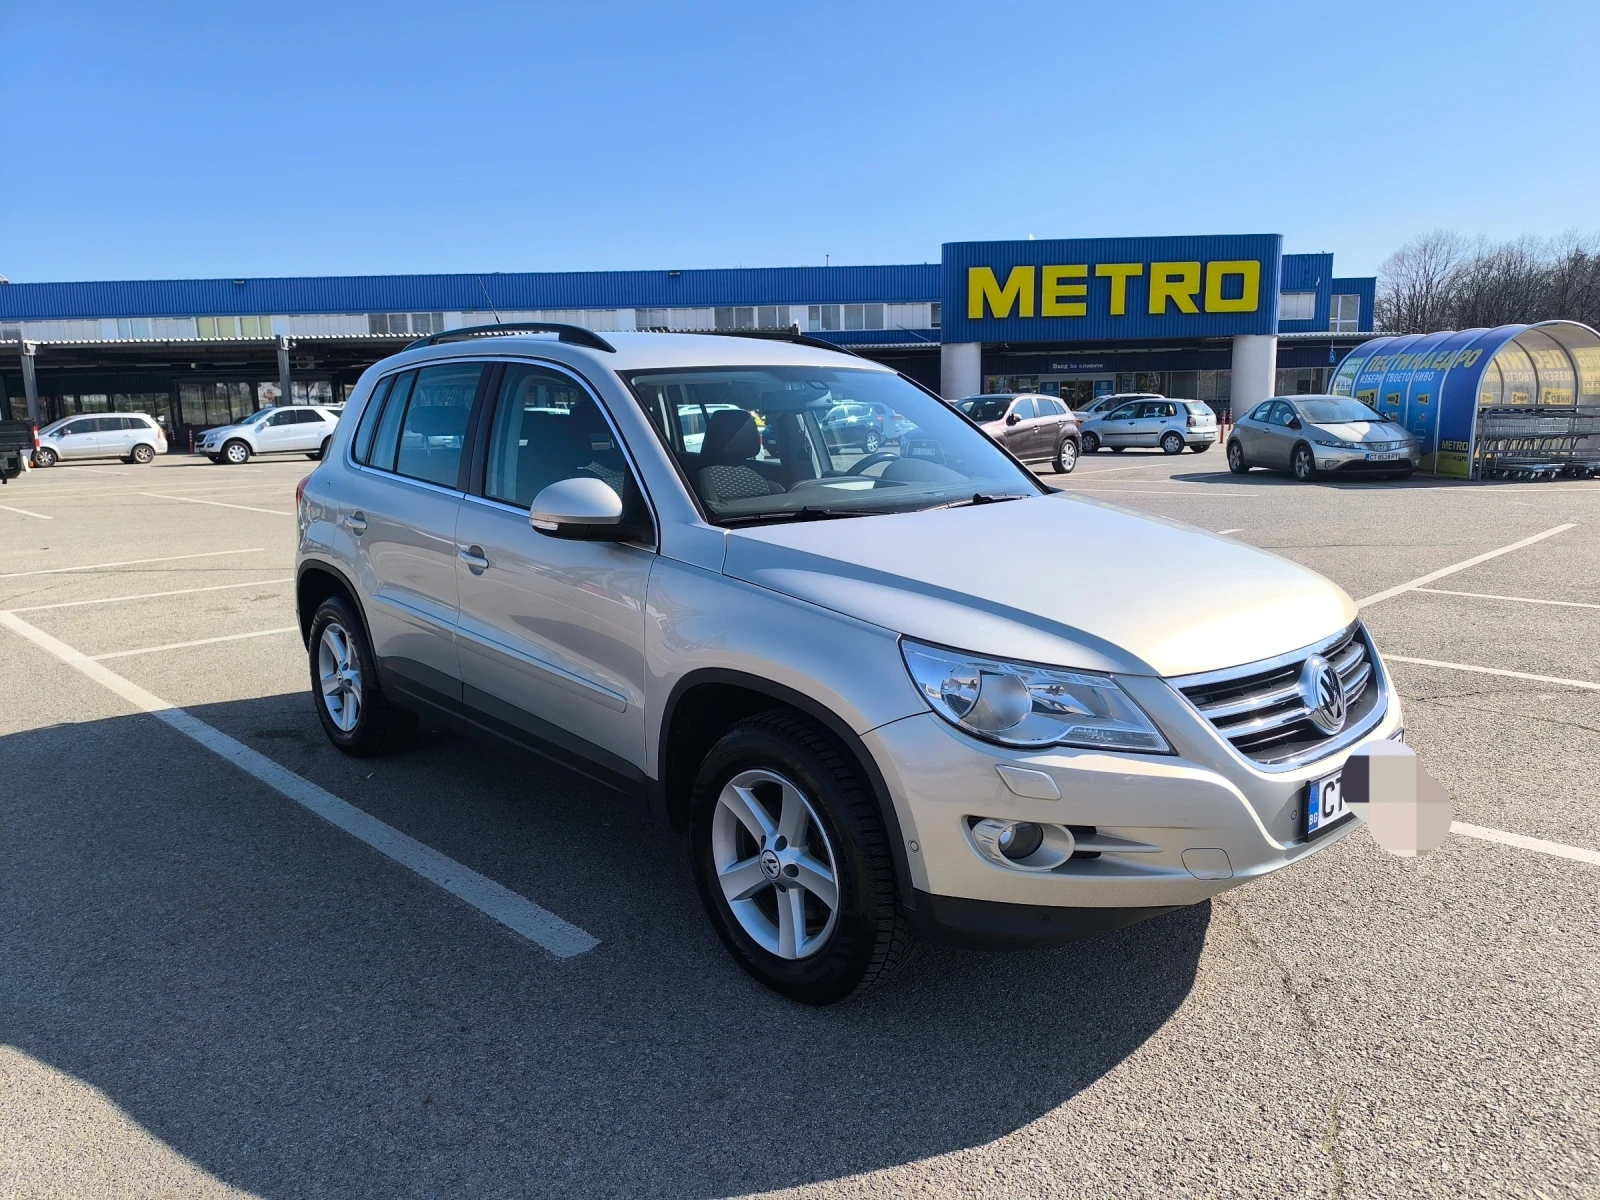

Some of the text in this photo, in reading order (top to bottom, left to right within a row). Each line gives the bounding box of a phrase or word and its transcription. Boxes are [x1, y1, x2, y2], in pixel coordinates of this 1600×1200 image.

[967, 260, 1261, 319] METRO
[1365, 354, 1415, 372] ПЕСТИ
[1359, 371, 1435, 384] ИЗБЕРИ ТВОЕТО НИВО
[1441, 439, 1468, 451] METRO
[1308, 811, 1318, 825] BG
